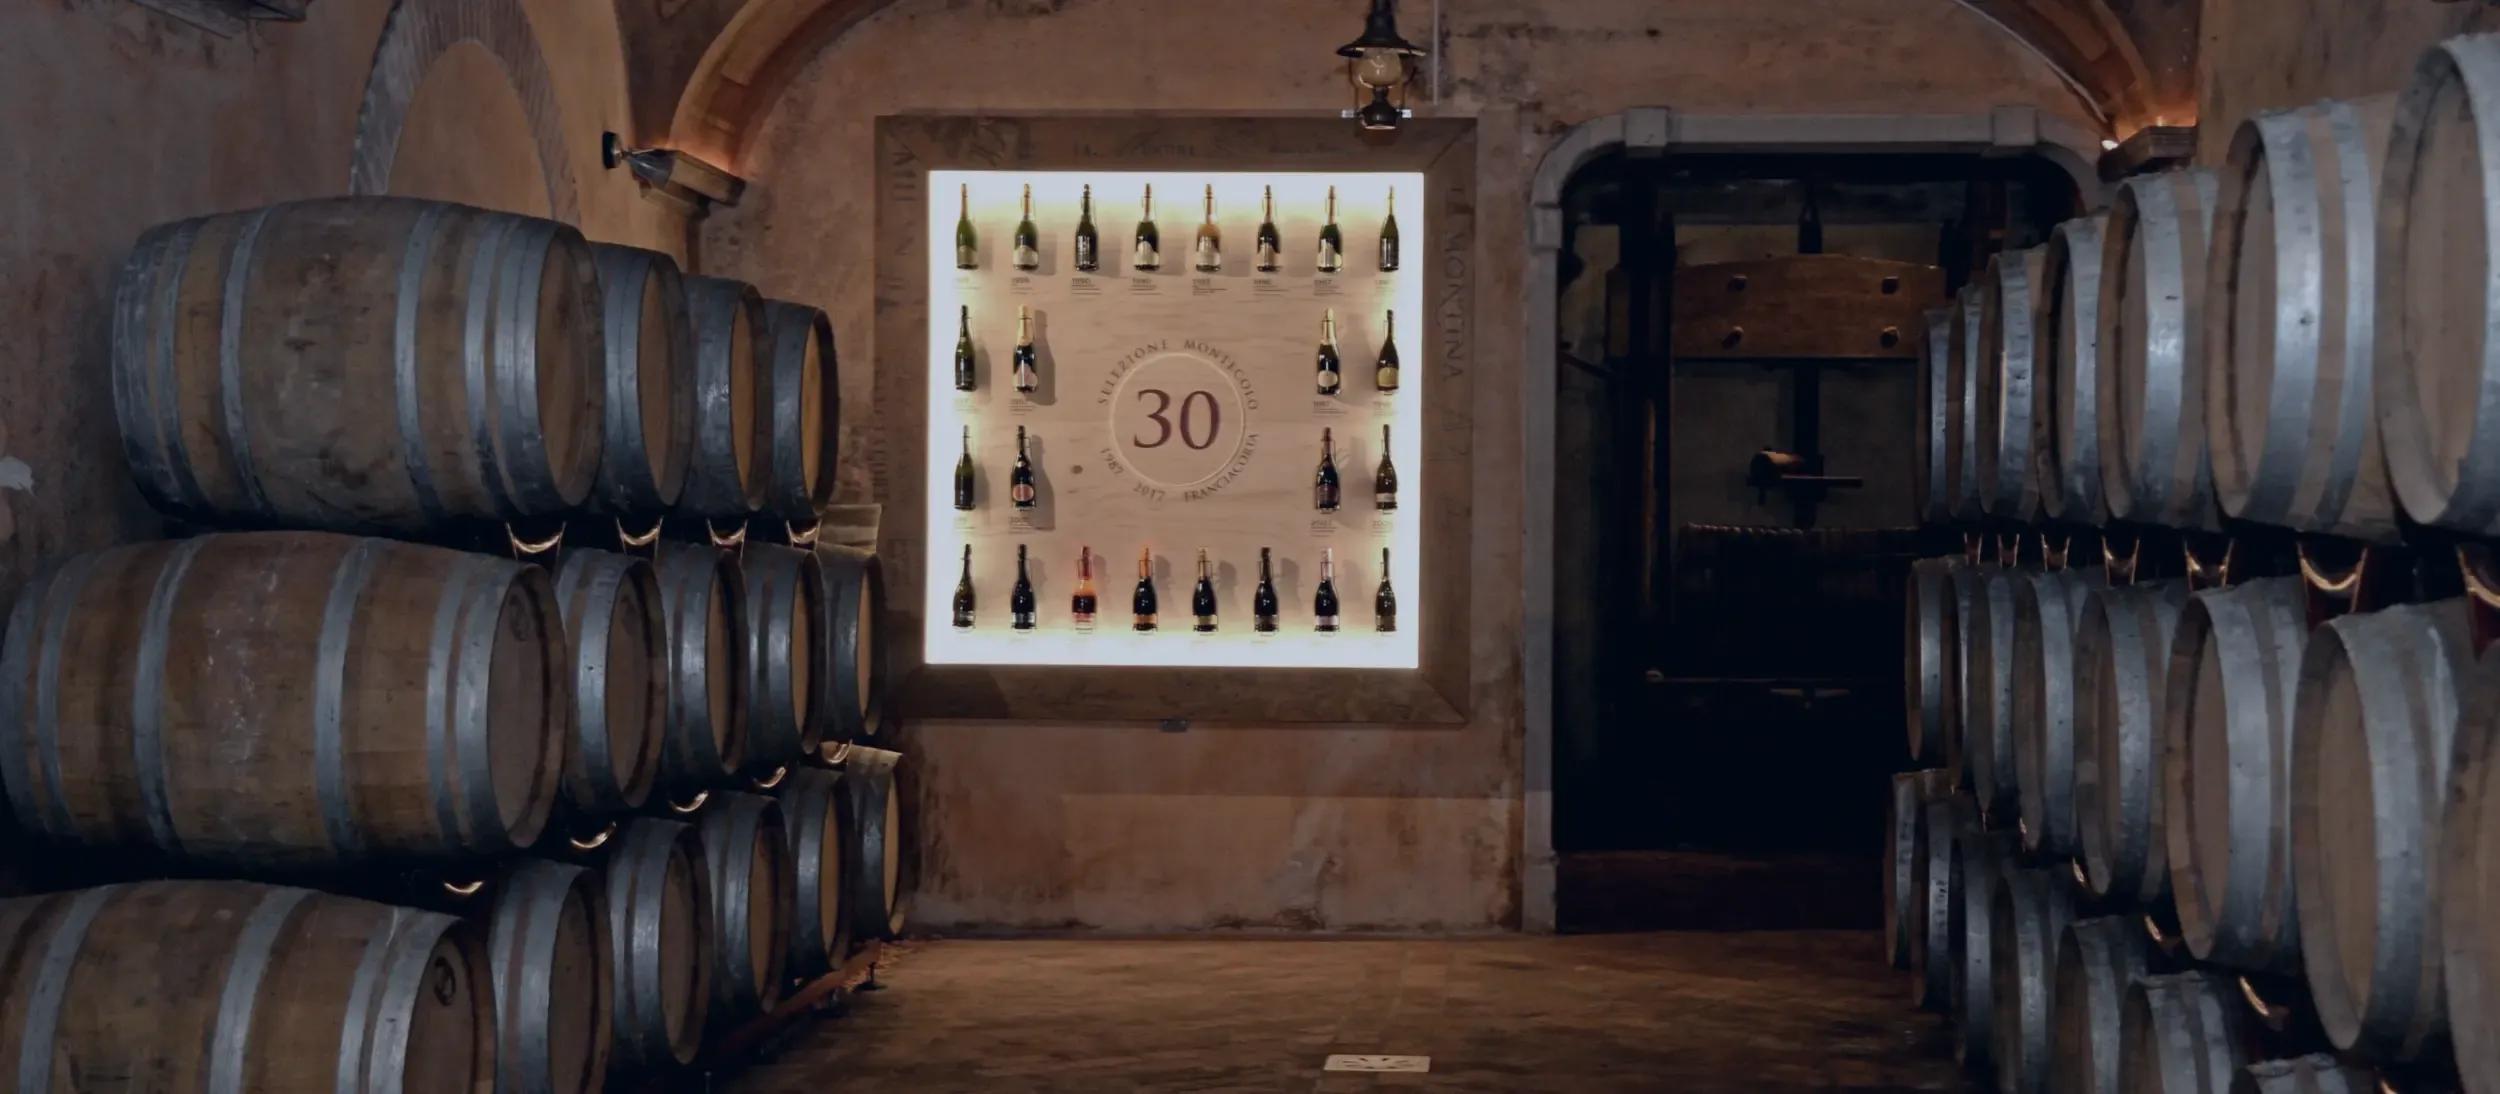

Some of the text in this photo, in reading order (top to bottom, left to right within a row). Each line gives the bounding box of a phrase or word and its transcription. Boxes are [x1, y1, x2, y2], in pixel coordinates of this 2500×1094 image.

[1184, 339, 1258, 411] MONTECOLO
[1134, 389, 1221, 450] 30
[1100, 433, 1259, 502] 1987 2017 FRANCIACORTA
